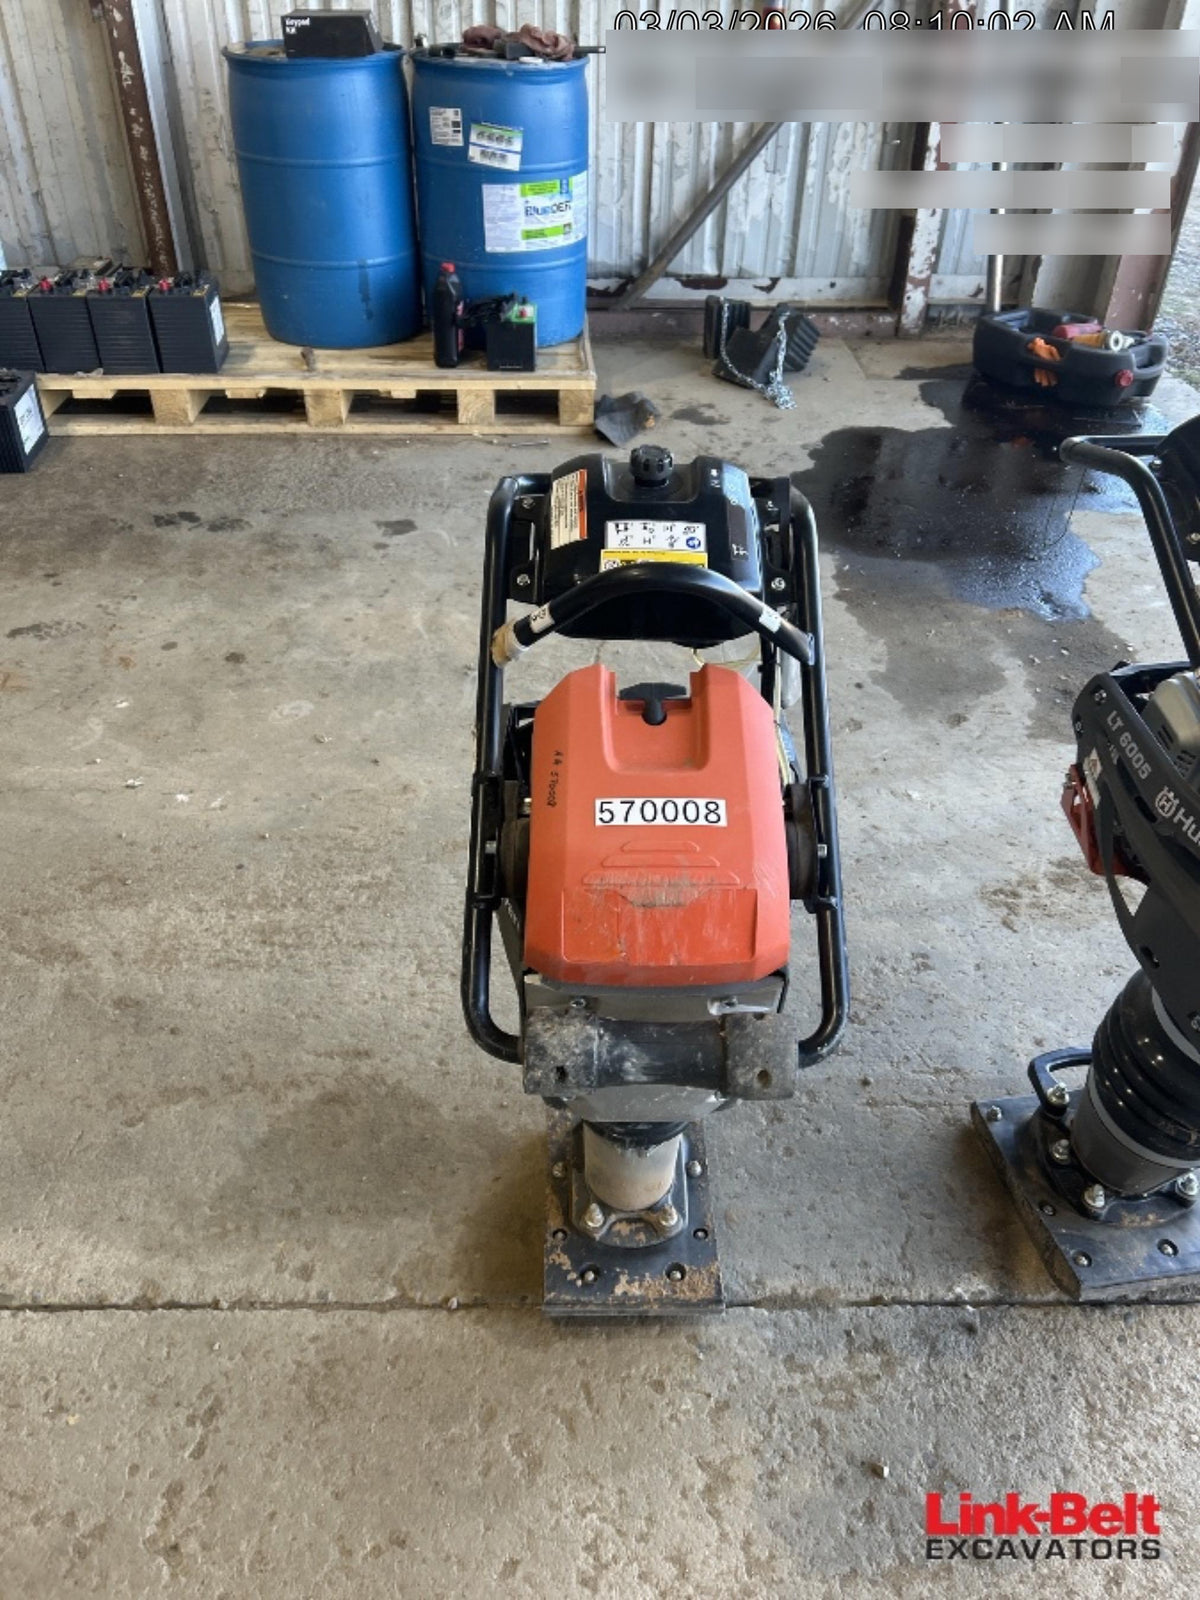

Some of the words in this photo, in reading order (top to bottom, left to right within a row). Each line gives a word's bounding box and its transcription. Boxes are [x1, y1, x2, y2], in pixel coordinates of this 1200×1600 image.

[1107, 710, 1125, 731] LT
[1119, 732, 1152, 780] 6005
[598, 800, 721, 824] 570008
[1173, 807, 1200, 846] Hu
